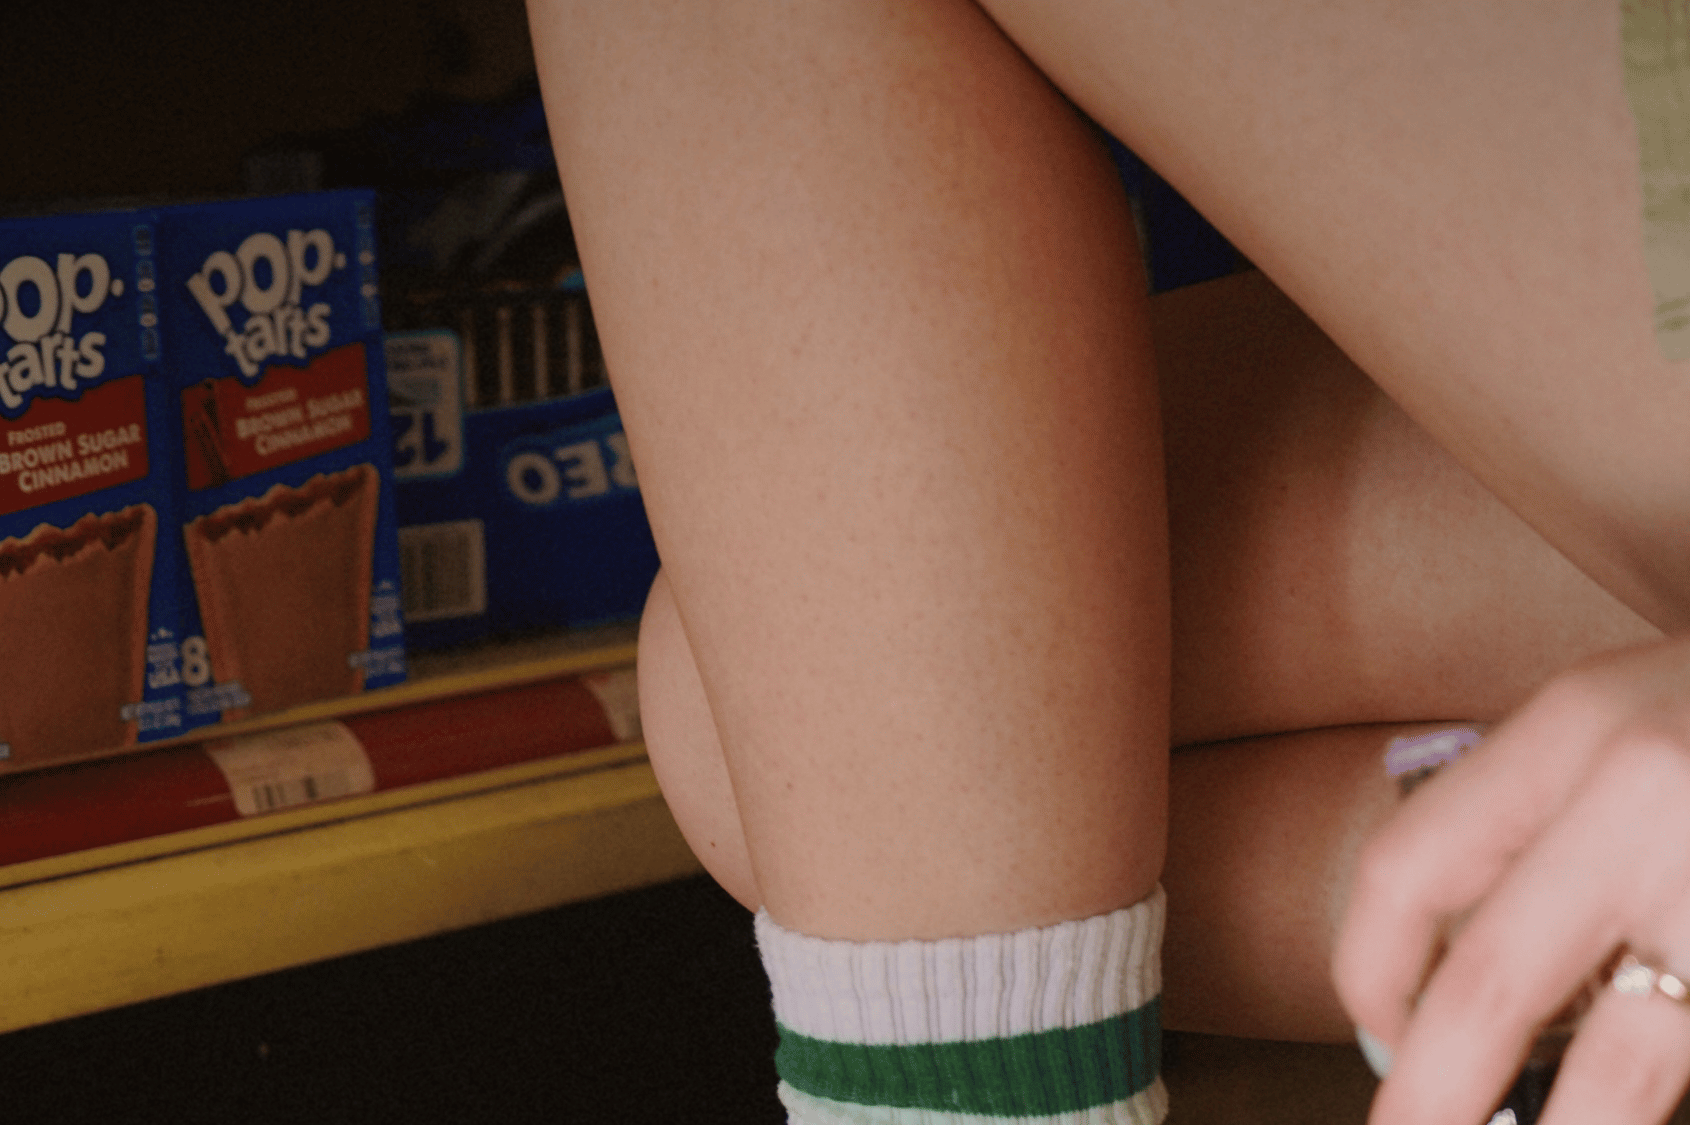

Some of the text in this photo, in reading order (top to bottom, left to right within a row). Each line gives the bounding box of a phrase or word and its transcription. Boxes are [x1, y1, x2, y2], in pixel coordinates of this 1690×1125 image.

[0, 423, 142, 475] BROWN SUGAR
[18, 449, 129, 494] CINNAMON
